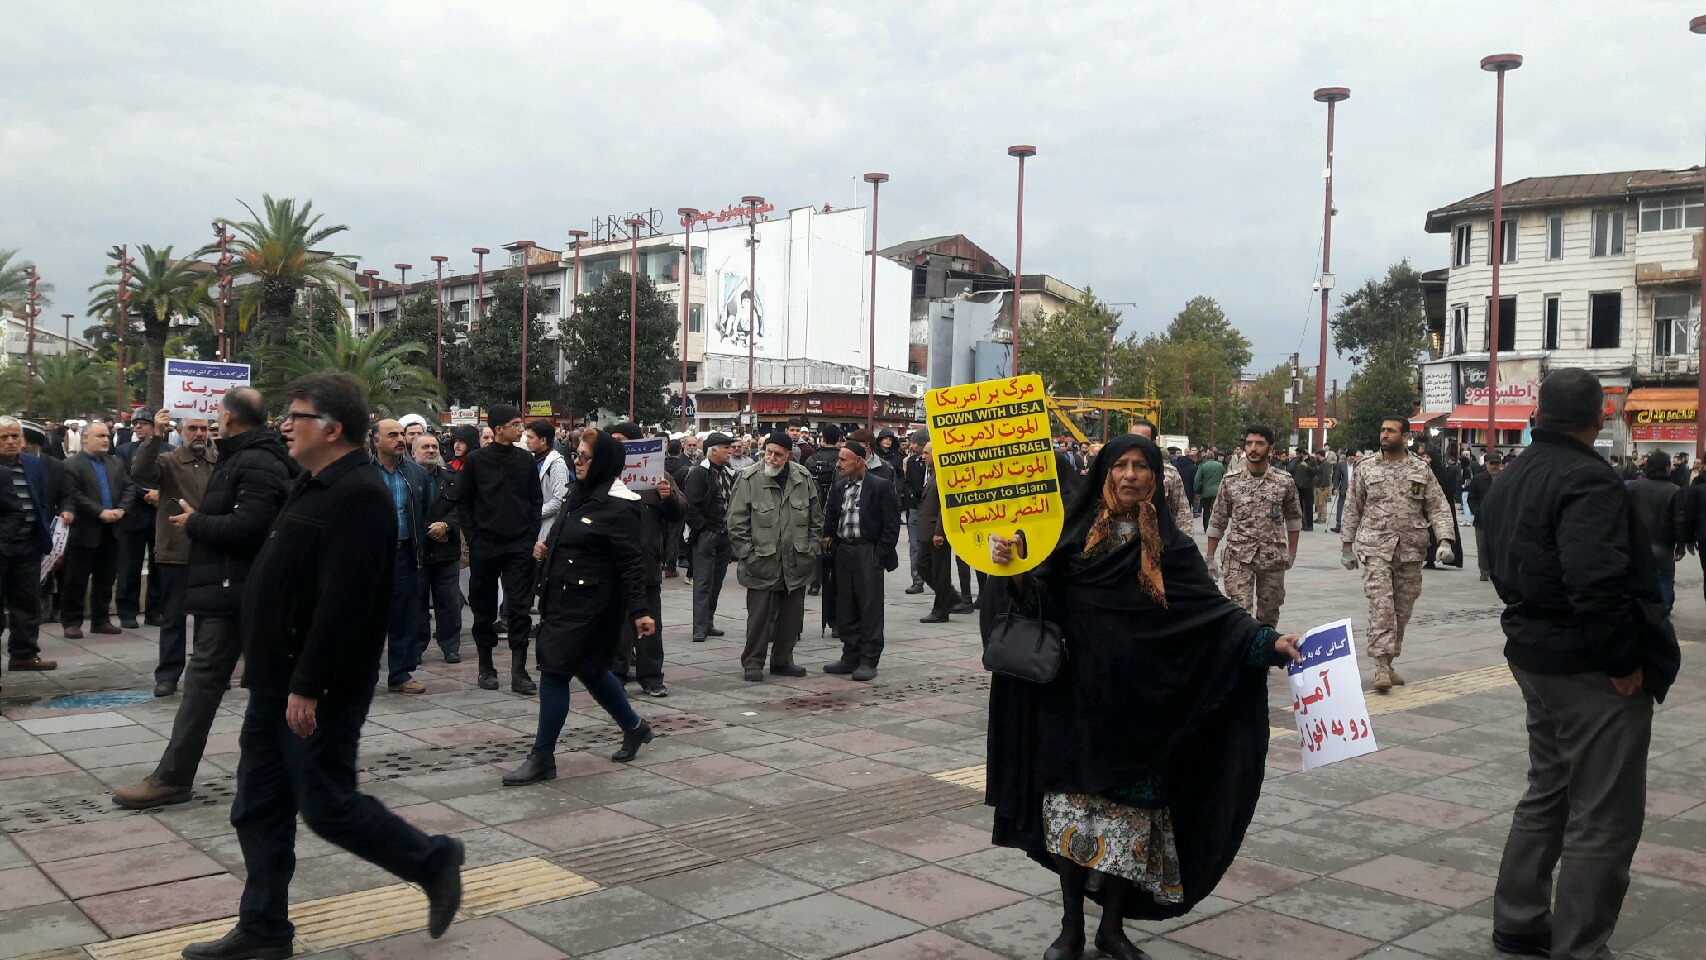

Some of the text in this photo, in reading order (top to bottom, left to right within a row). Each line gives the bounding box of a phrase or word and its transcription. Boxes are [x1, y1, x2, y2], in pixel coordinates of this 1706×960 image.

[174, 399, 197, 408] است
[936, 379, 1034, 409] مرگ بر امریکا
[937, 404, 1040, 427] DOWN WITH U.S.A
[998, 417, 1038, 439] الموت
[941, 441, 1048, 466] DOWN WITH ISRAEL
[1008, 456, 1048, 478] الموت
[640, 475, 648, 484] به
[954, 482, 1048, 504] Victory to Islam
[959, 504, 1006, 534] للاسلام
[1308, 651, 1314, 661] به
[1315, 645, 1322, 656] که
[1326, 638, 1346, 656] کسانی
[1306, 718, 1328, 752] افول
[1332, 719, 1347, 742] به
[1350, 718, 1368, 741] رو
